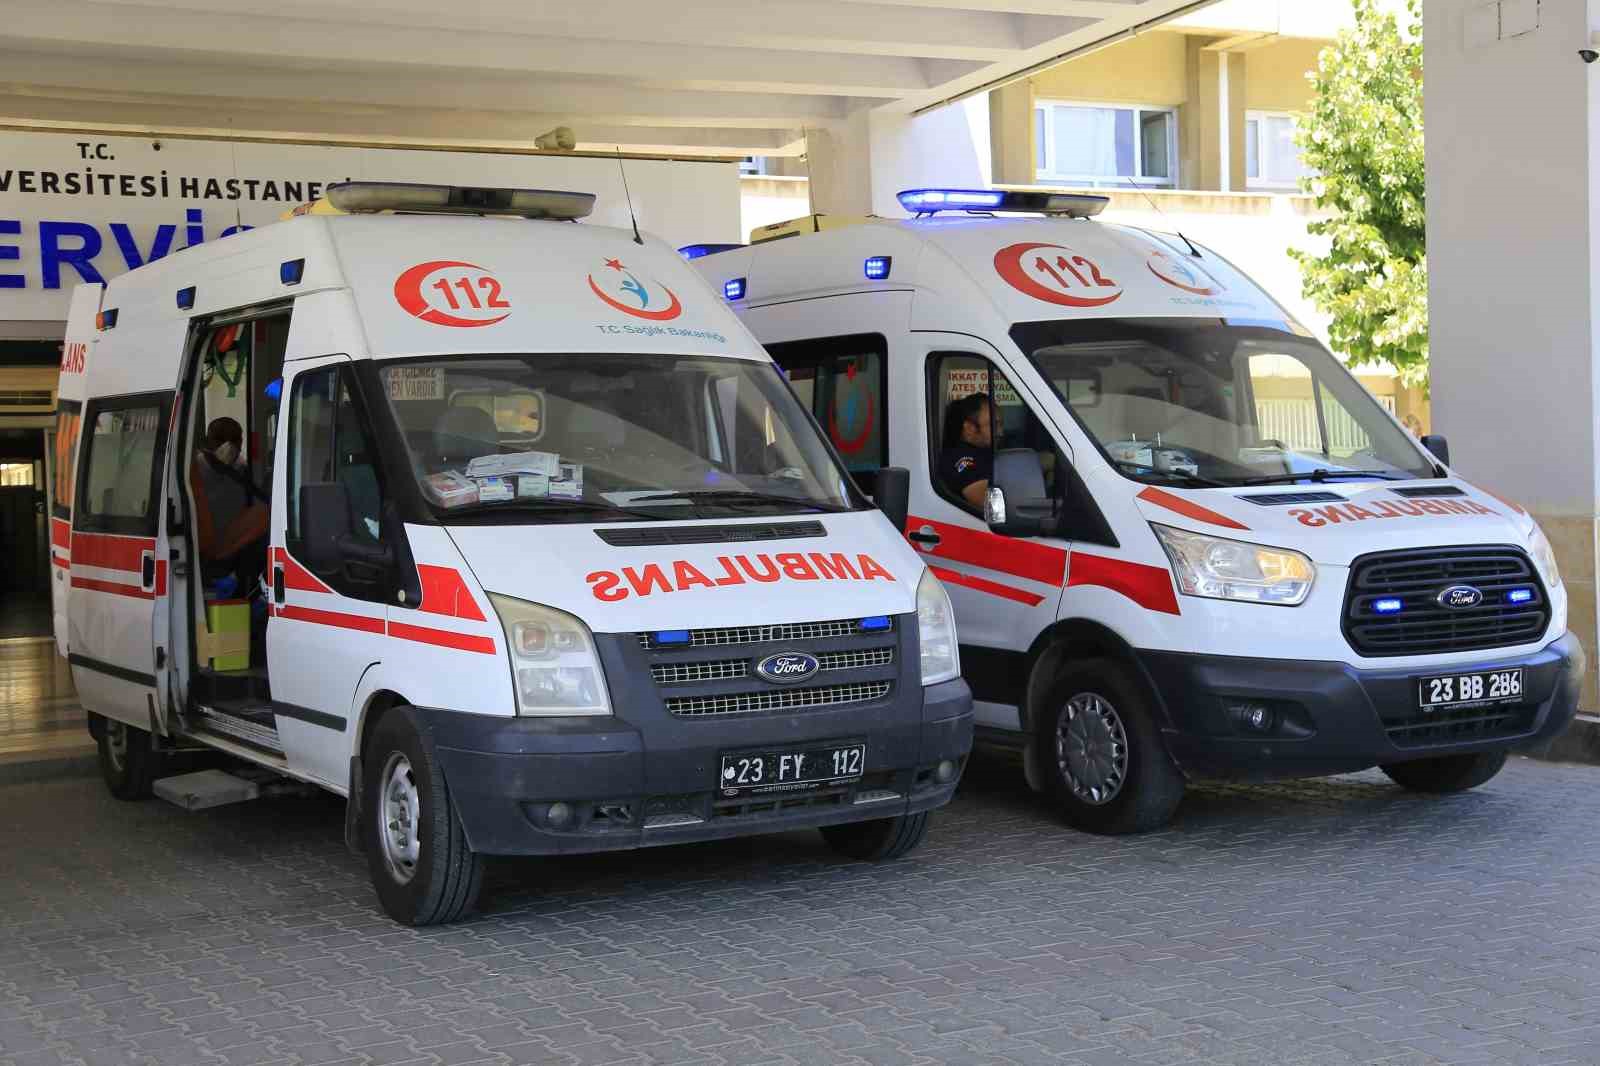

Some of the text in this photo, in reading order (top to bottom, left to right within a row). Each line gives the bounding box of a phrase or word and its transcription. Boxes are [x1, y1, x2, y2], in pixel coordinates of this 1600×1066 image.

[76, 142, 115, 160] T.C.
[180, 177, 351, 202] HASTANE
[1035, 255, 1116, 288] 112
[432, 276, 511, 309] 112
[774, 657, 807, 674] Ford
[1430, 671, 1520, 702] 23 BB 286
[737, 749, 860, 783] 23 FY 112
